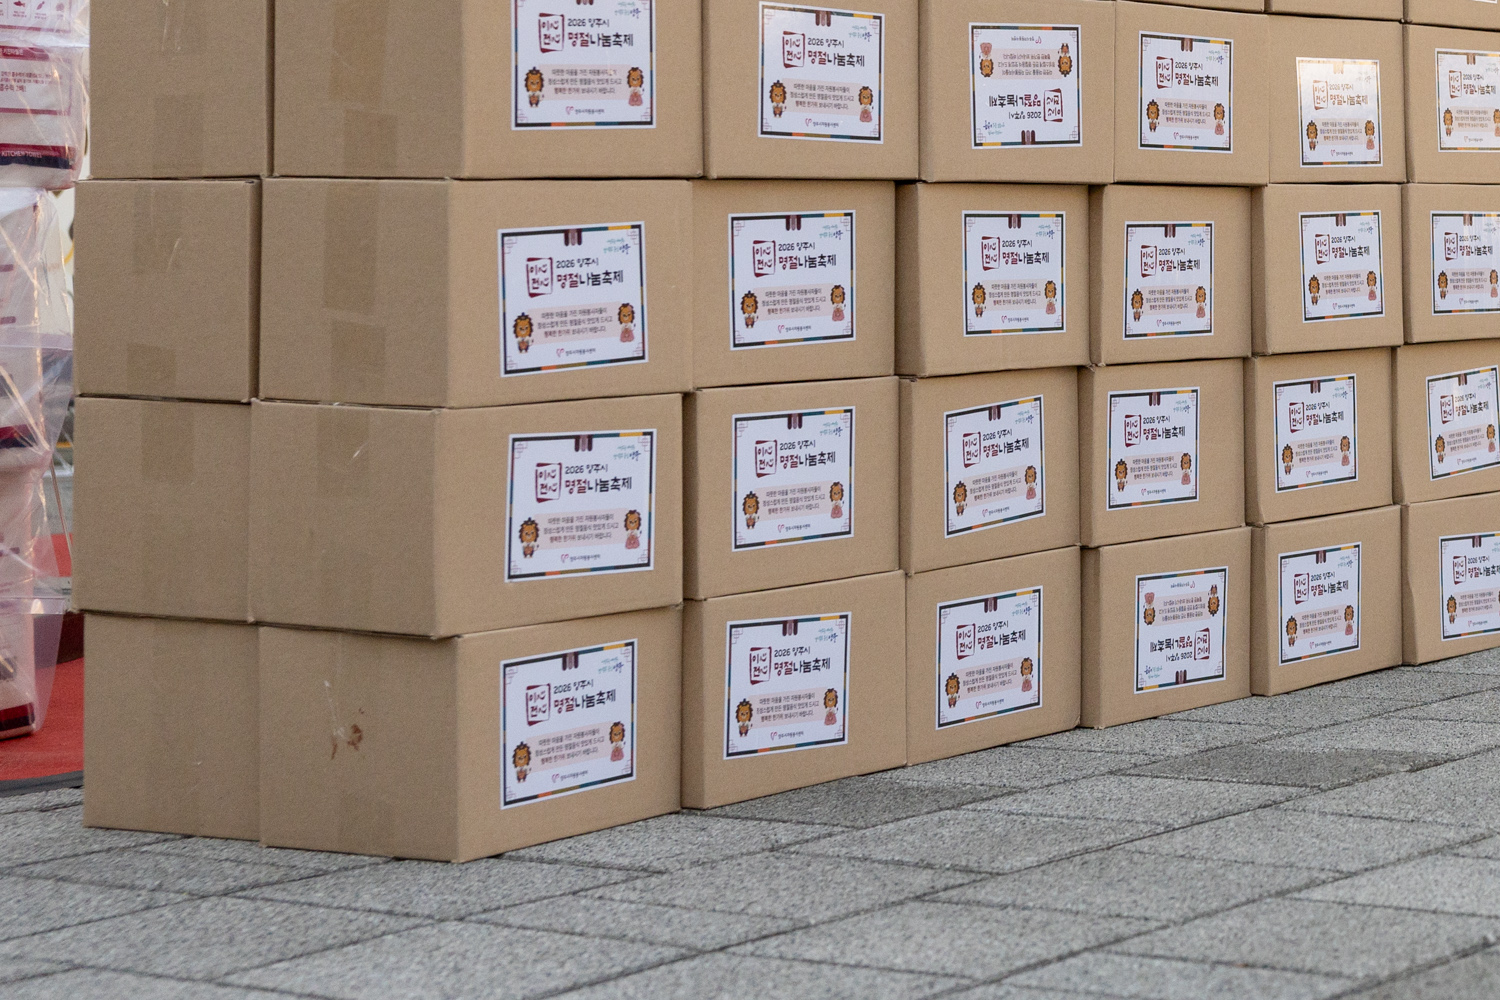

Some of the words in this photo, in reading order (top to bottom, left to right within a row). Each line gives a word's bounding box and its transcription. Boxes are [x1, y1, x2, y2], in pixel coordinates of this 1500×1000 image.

[567, 18, 585, 27] 2026
[567, 32, 633, 48] 명절나눔축제
[808, 37, 824, 46] 2026
[808, 49, 865, 68] 명절나눔축제
[778, 242, 794, 251] 2026
[554, 258, 574, 268] 2026
[778, 253, 836, 270] 명절나눔축제
[1003, 250, 1050, 264] 명절나눔축제
[555, 267, 623, 288] 명절나눔축제
[779, 441, 795, 451] 2026
[983, 436, 1028, 458] 명절나눔축제
[779, 450, 836, 469] 명절나눔축제
[565, 464, 584, 474] 2026
[564, 475, 632, 494] 명절나눔축제
[978, 627, 1026, 649] 명절나눔축제
[774, 647, 790, 657] 2026
[773, 656, 830, 676] 명절나눔축제
[553, 683, 571, 695] 2026
[553, 688, 616, 715] 명절나눔축제
